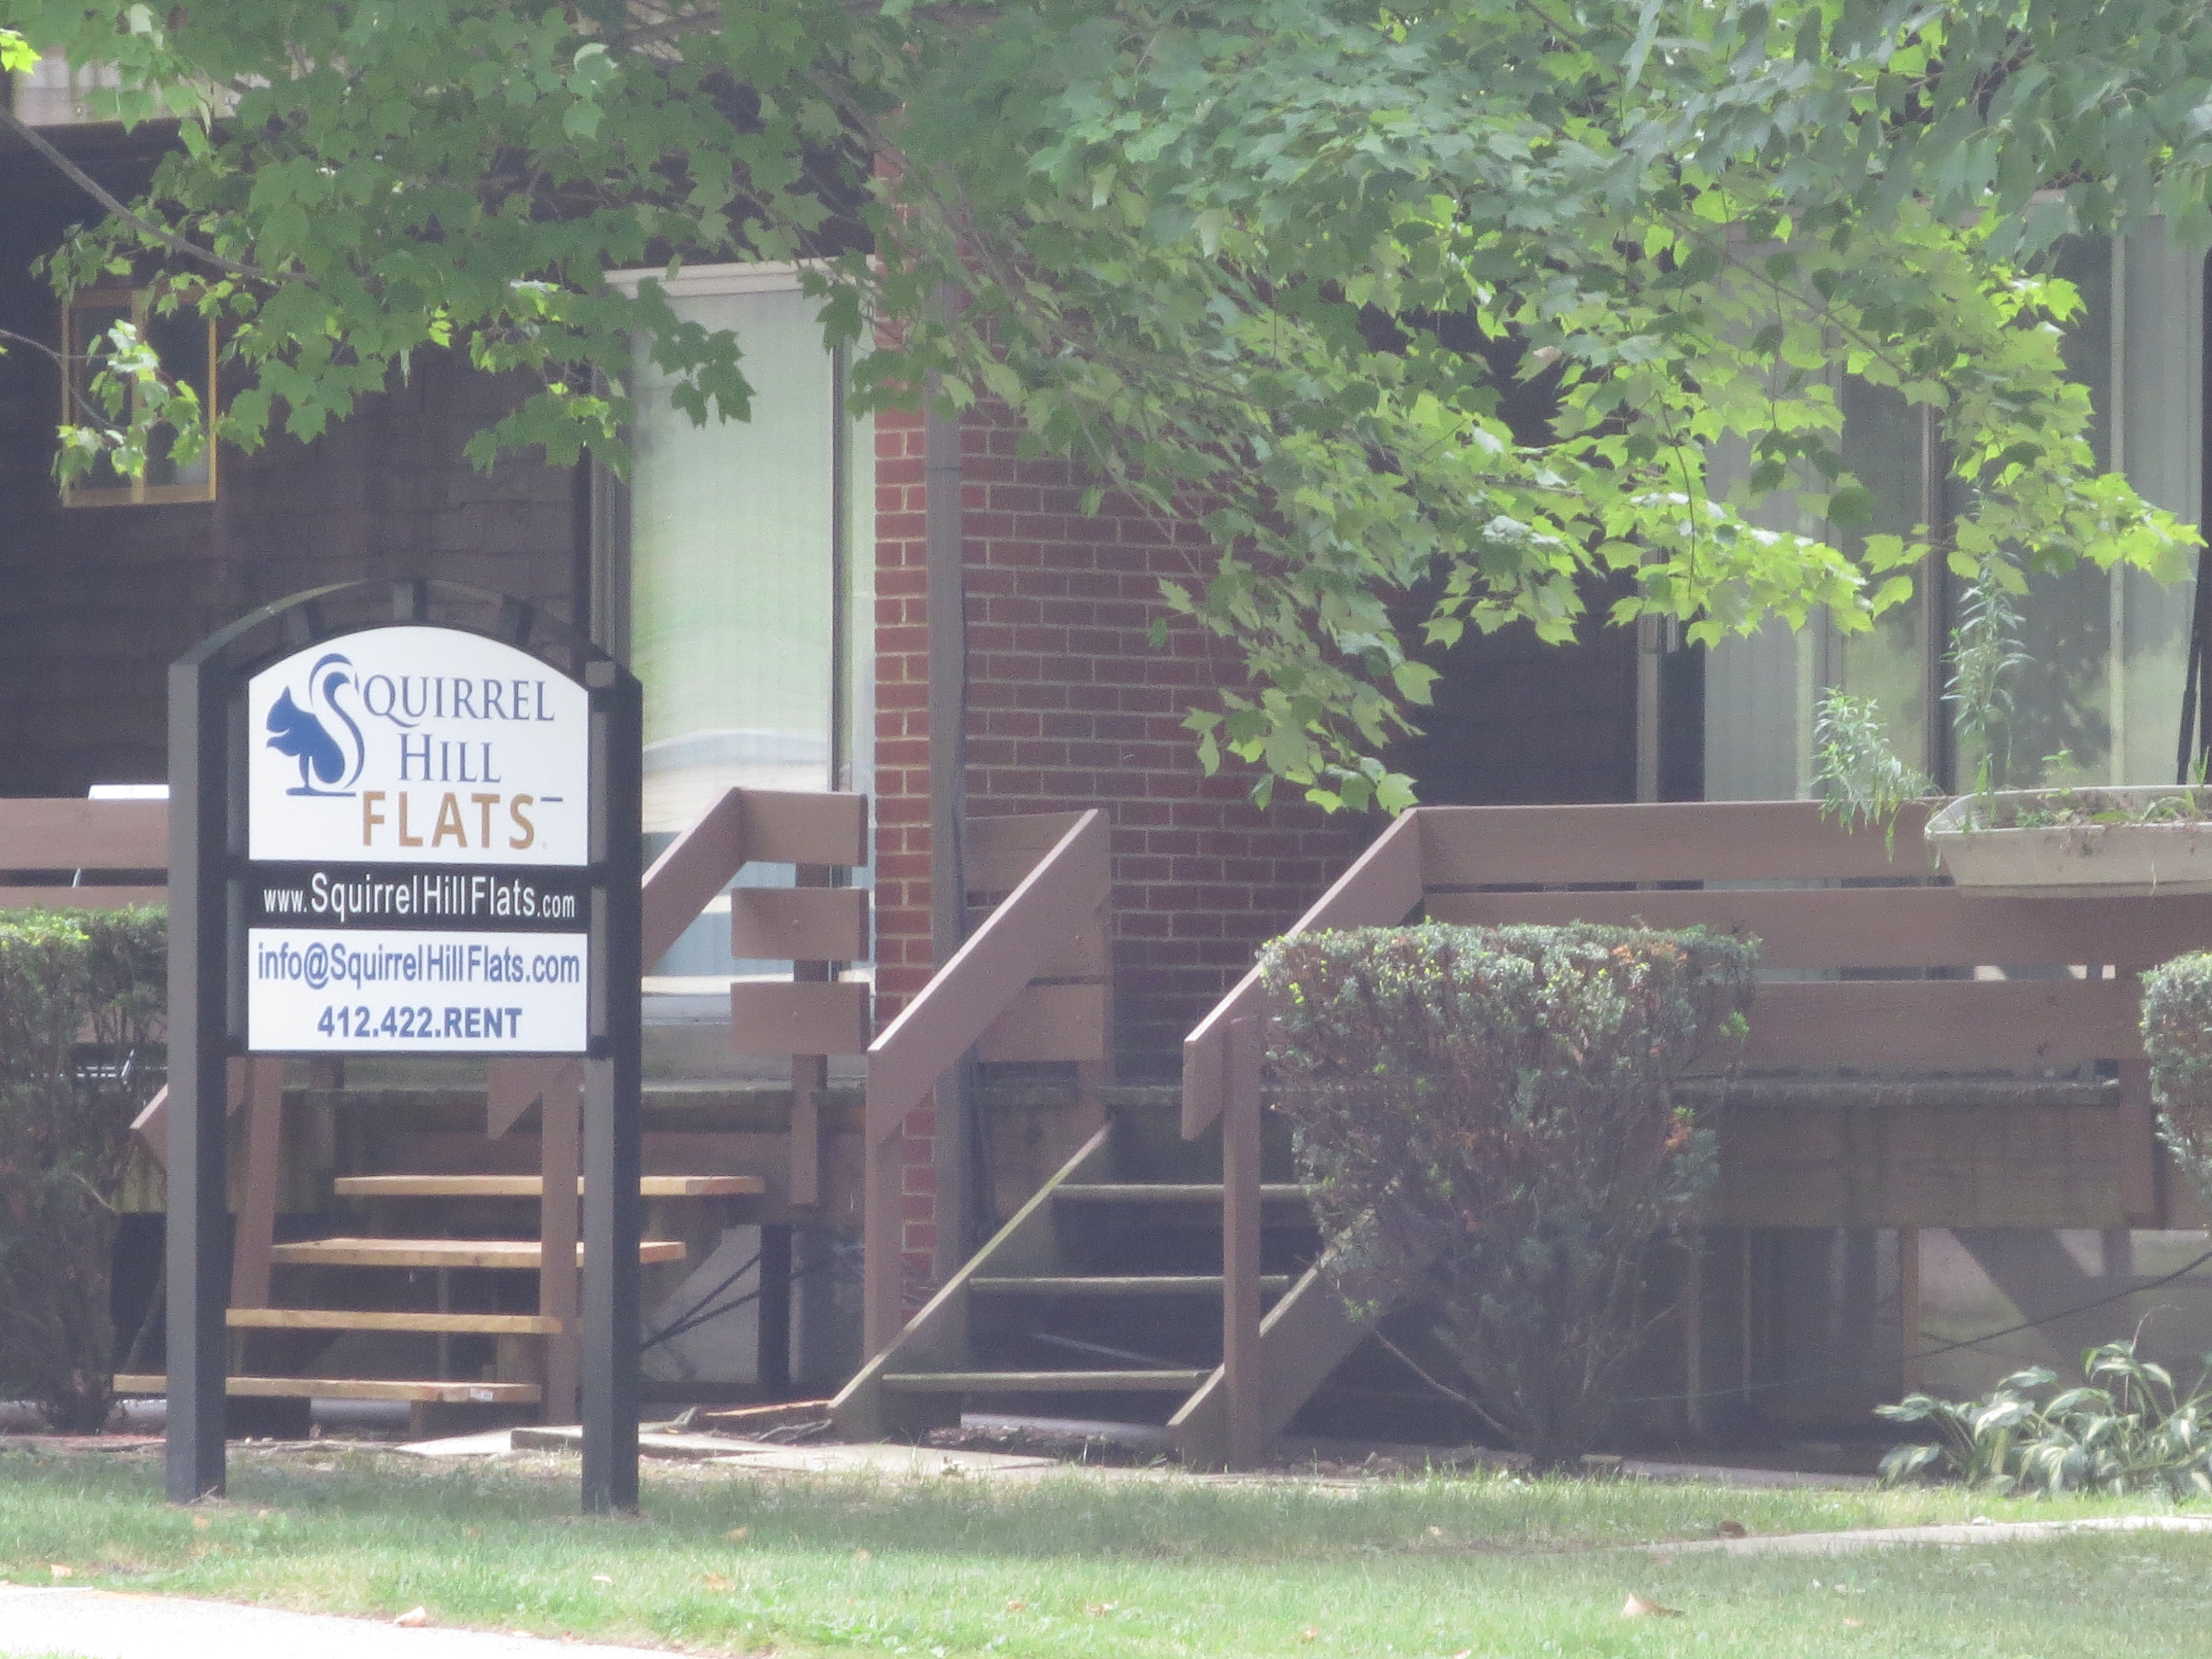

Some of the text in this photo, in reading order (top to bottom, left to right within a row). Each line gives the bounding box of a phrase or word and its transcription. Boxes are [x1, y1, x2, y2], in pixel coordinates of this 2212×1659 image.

[397, 733, 502, 783] HILL
[363, 791, 535, 850] FLATS
[263, 872, 575, 923] www.SquirrelHillFlats.com
[258, 942, 580, 990] info@SquirrelHillFlats.com
[318, 1006, 522, 1039] 412.422.RENT
